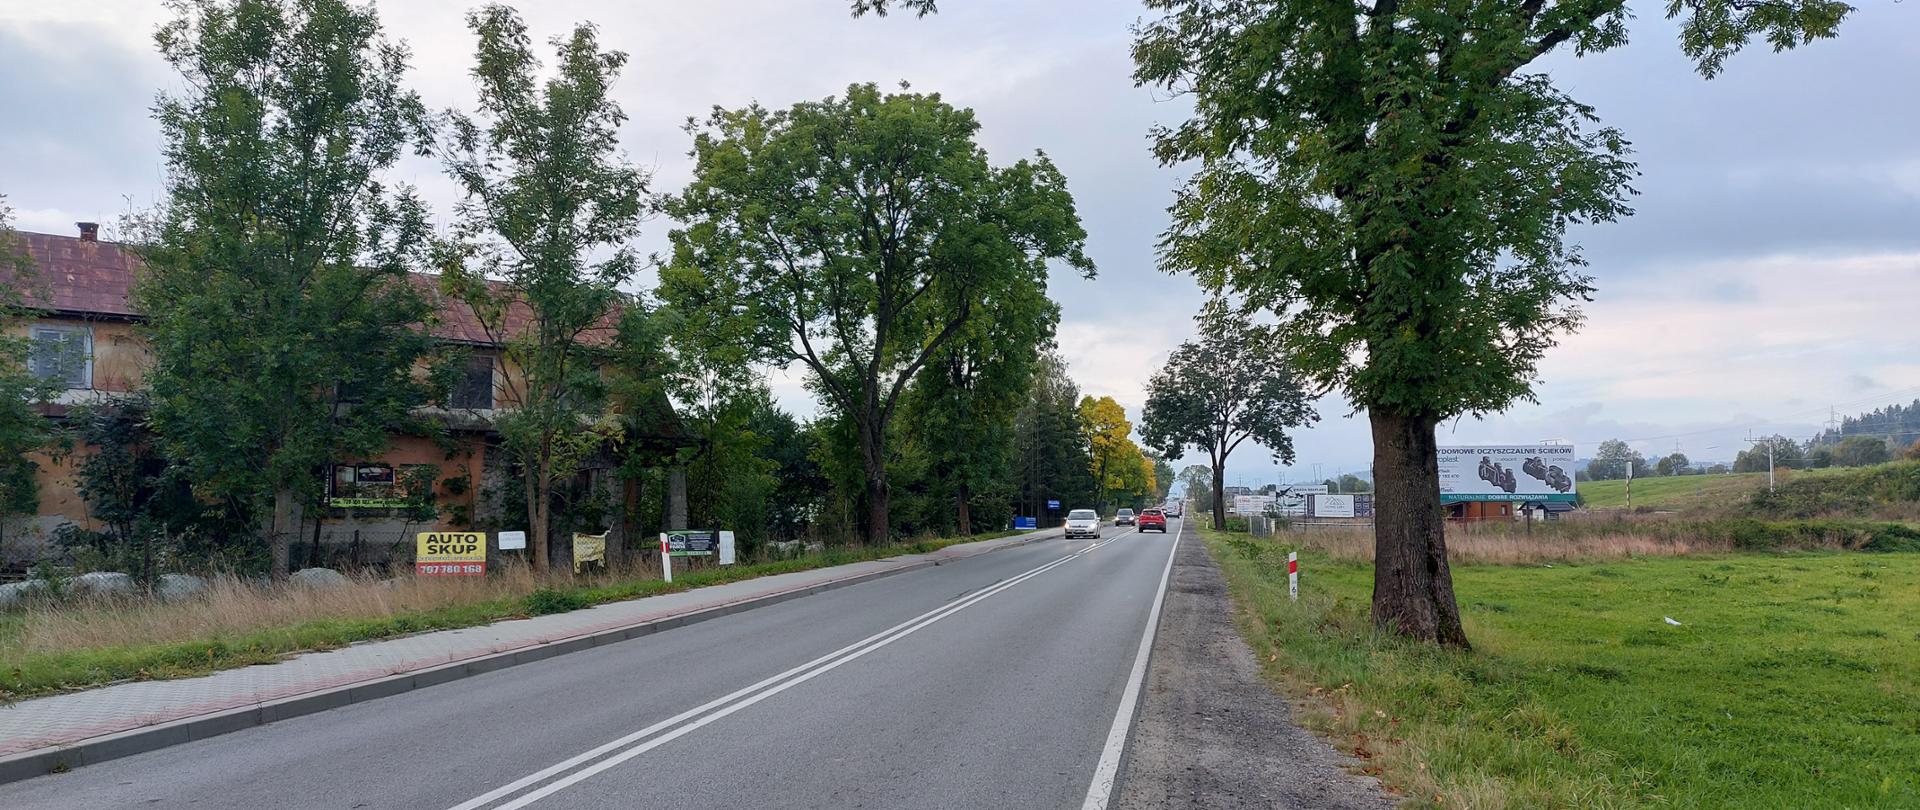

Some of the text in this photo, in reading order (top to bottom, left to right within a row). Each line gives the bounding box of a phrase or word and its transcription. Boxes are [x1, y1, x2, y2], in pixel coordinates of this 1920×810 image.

[1538, 446, 1572, 454] ŚCIEKÓW
[426, 534, 478, 544] AUTO
[427, 545, 477, 555] SKUP
